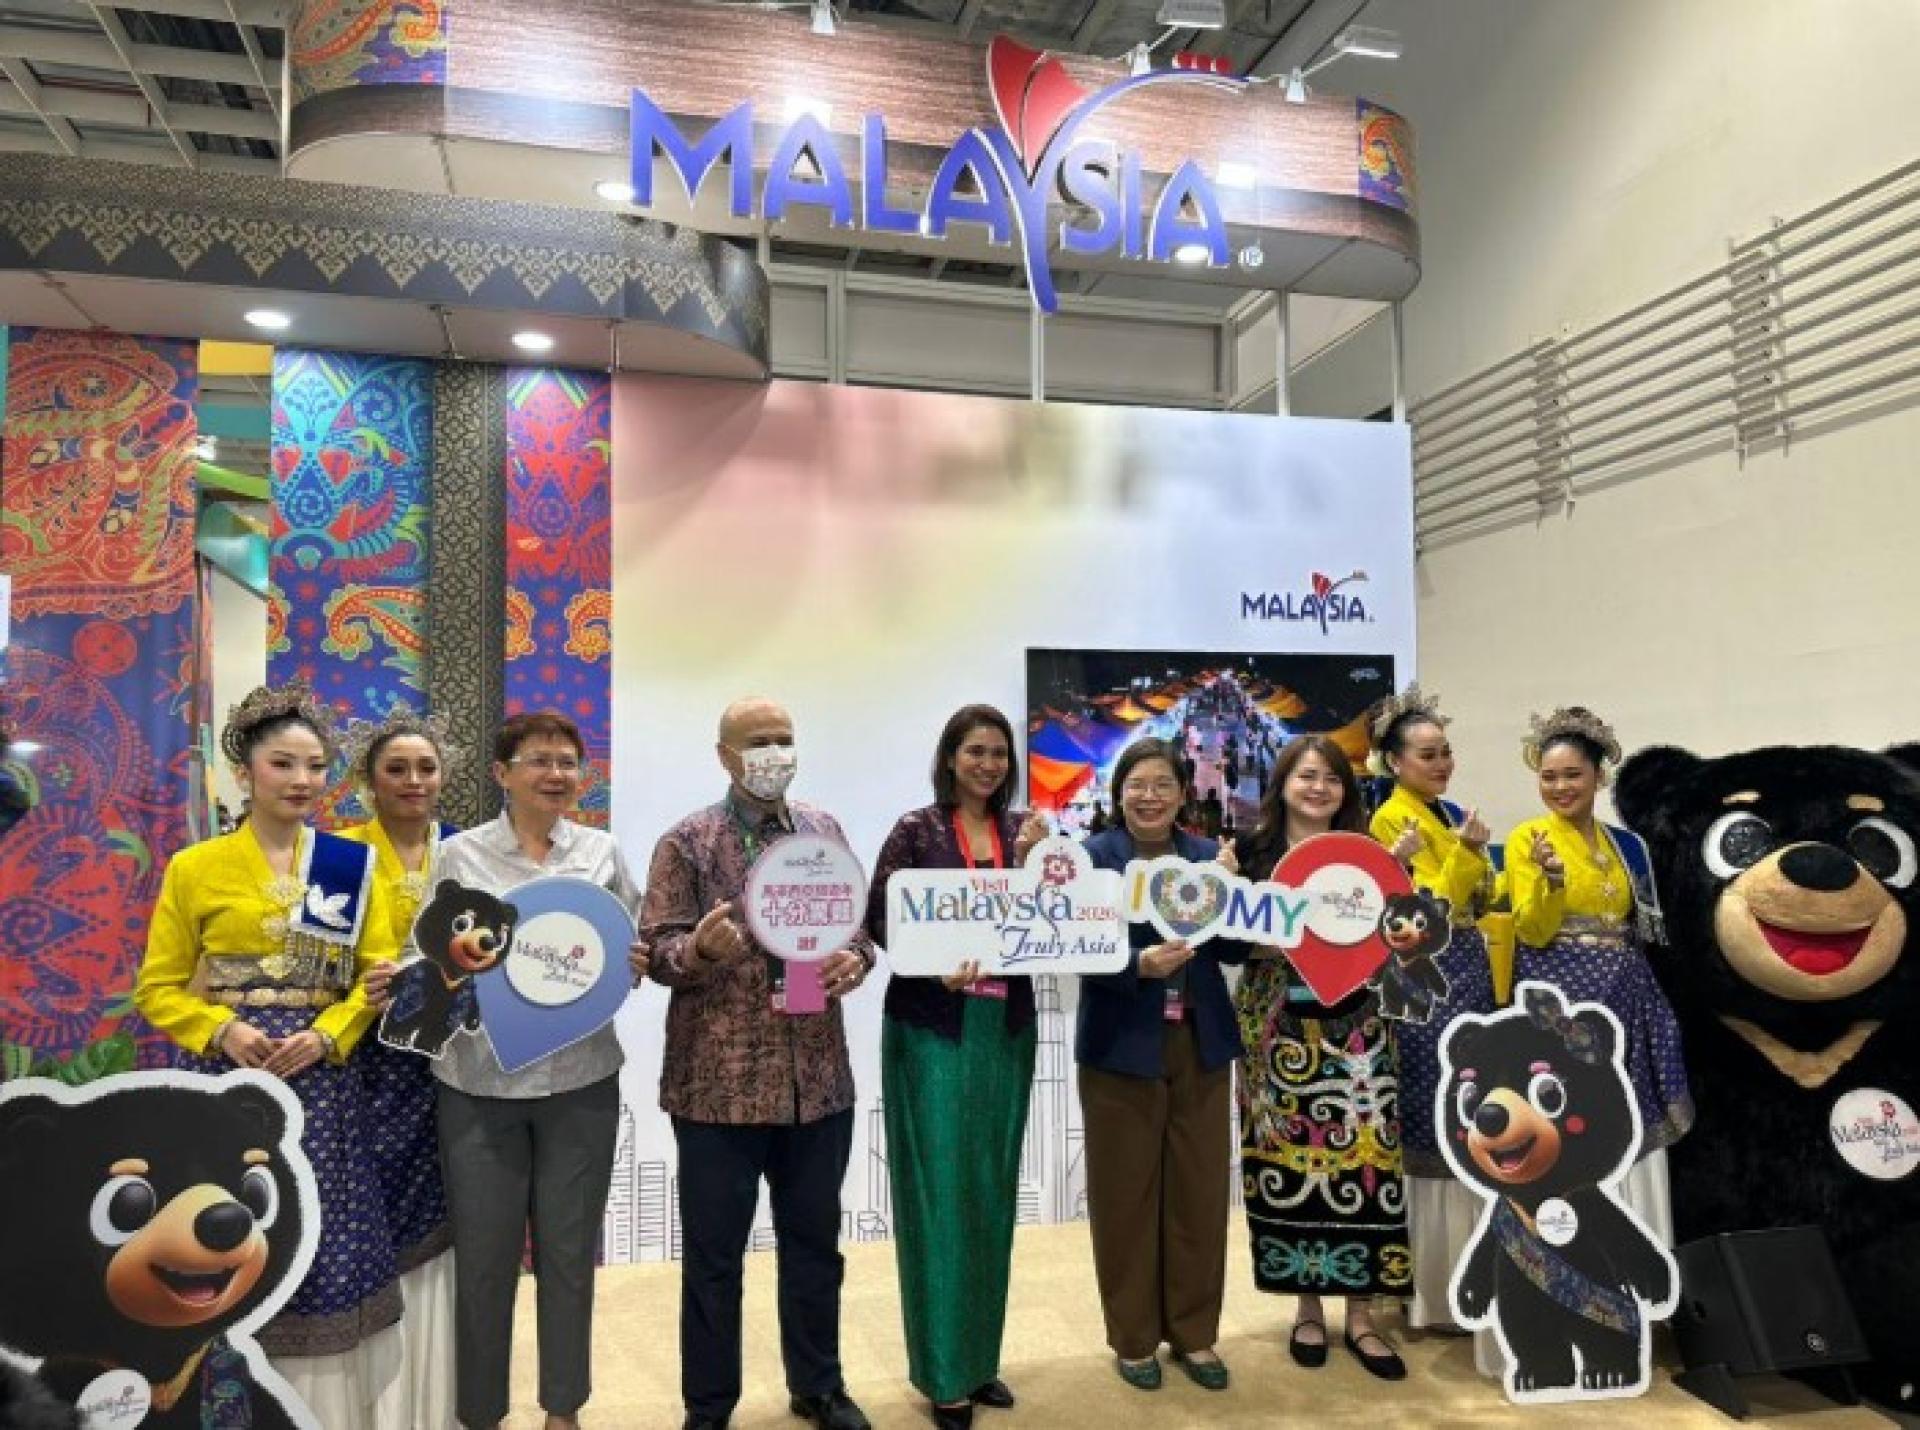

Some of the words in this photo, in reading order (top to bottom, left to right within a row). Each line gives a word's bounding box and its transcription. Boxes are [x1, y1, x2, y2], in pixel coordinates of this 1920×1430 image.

[630, 60, 1232, 313] MALAYSIA
[1241, 582, 1366, 634] MALAYSIA
[900, 884, 1073, 926] Malaysia
[970, 879, 1009, 893] Visit
[1131, 870, 1147, 912] I
[1226, 887, 1309, 937] MY
[995, 925, 1066, 967] Truly
[1070, 934, 1119, 955] Asia
